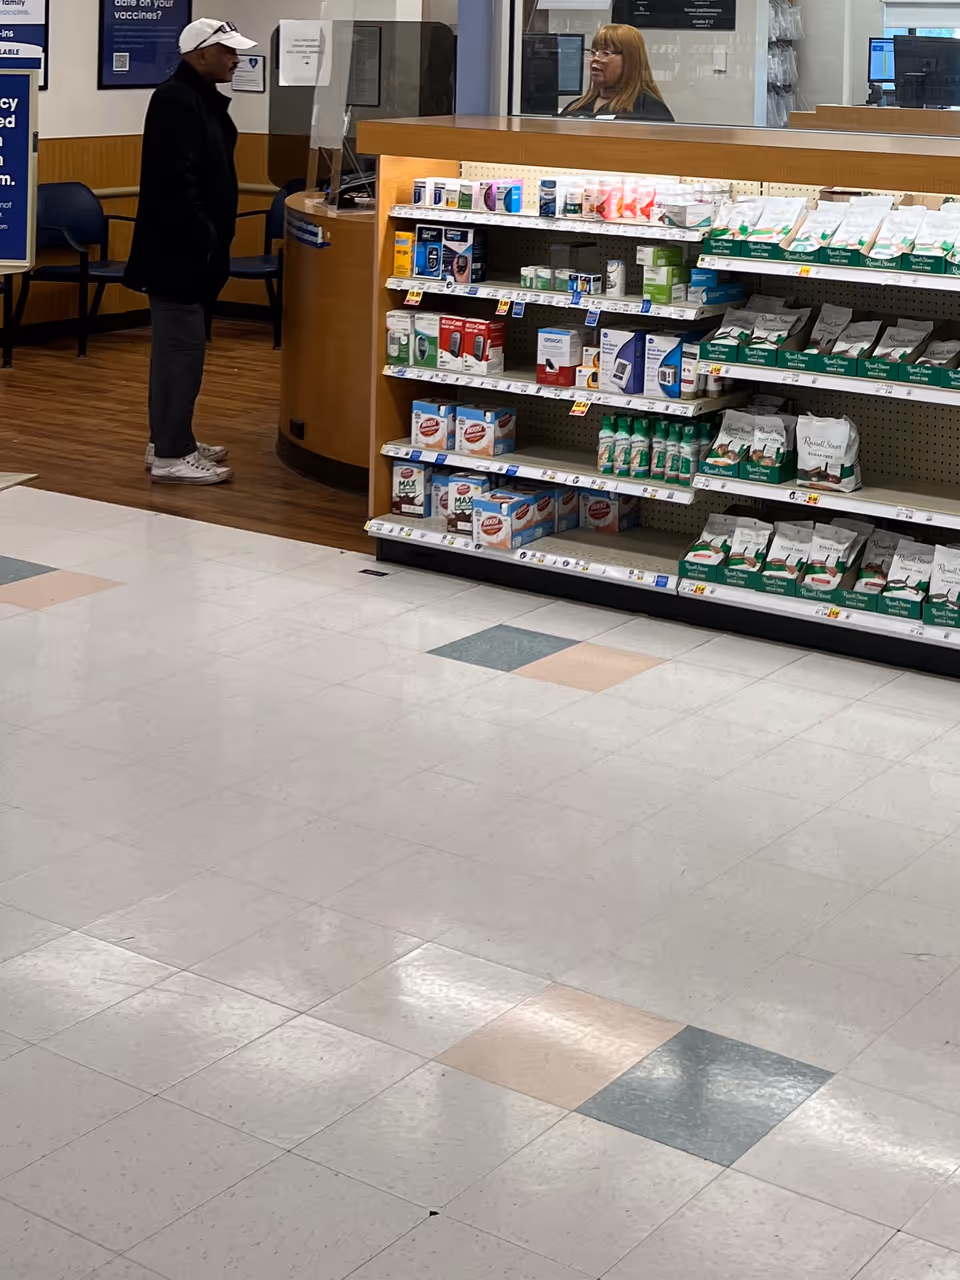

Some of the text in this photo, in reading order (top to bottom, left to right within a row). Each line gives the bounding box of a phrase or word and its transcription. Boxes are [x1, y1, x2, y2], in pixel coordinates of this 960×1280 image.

[139, 0, 151, 7] on
[154, 0, 174, 8] your
[114, 10, 162, 20] vaccines?
[455, 496, 473, 505] MAX
